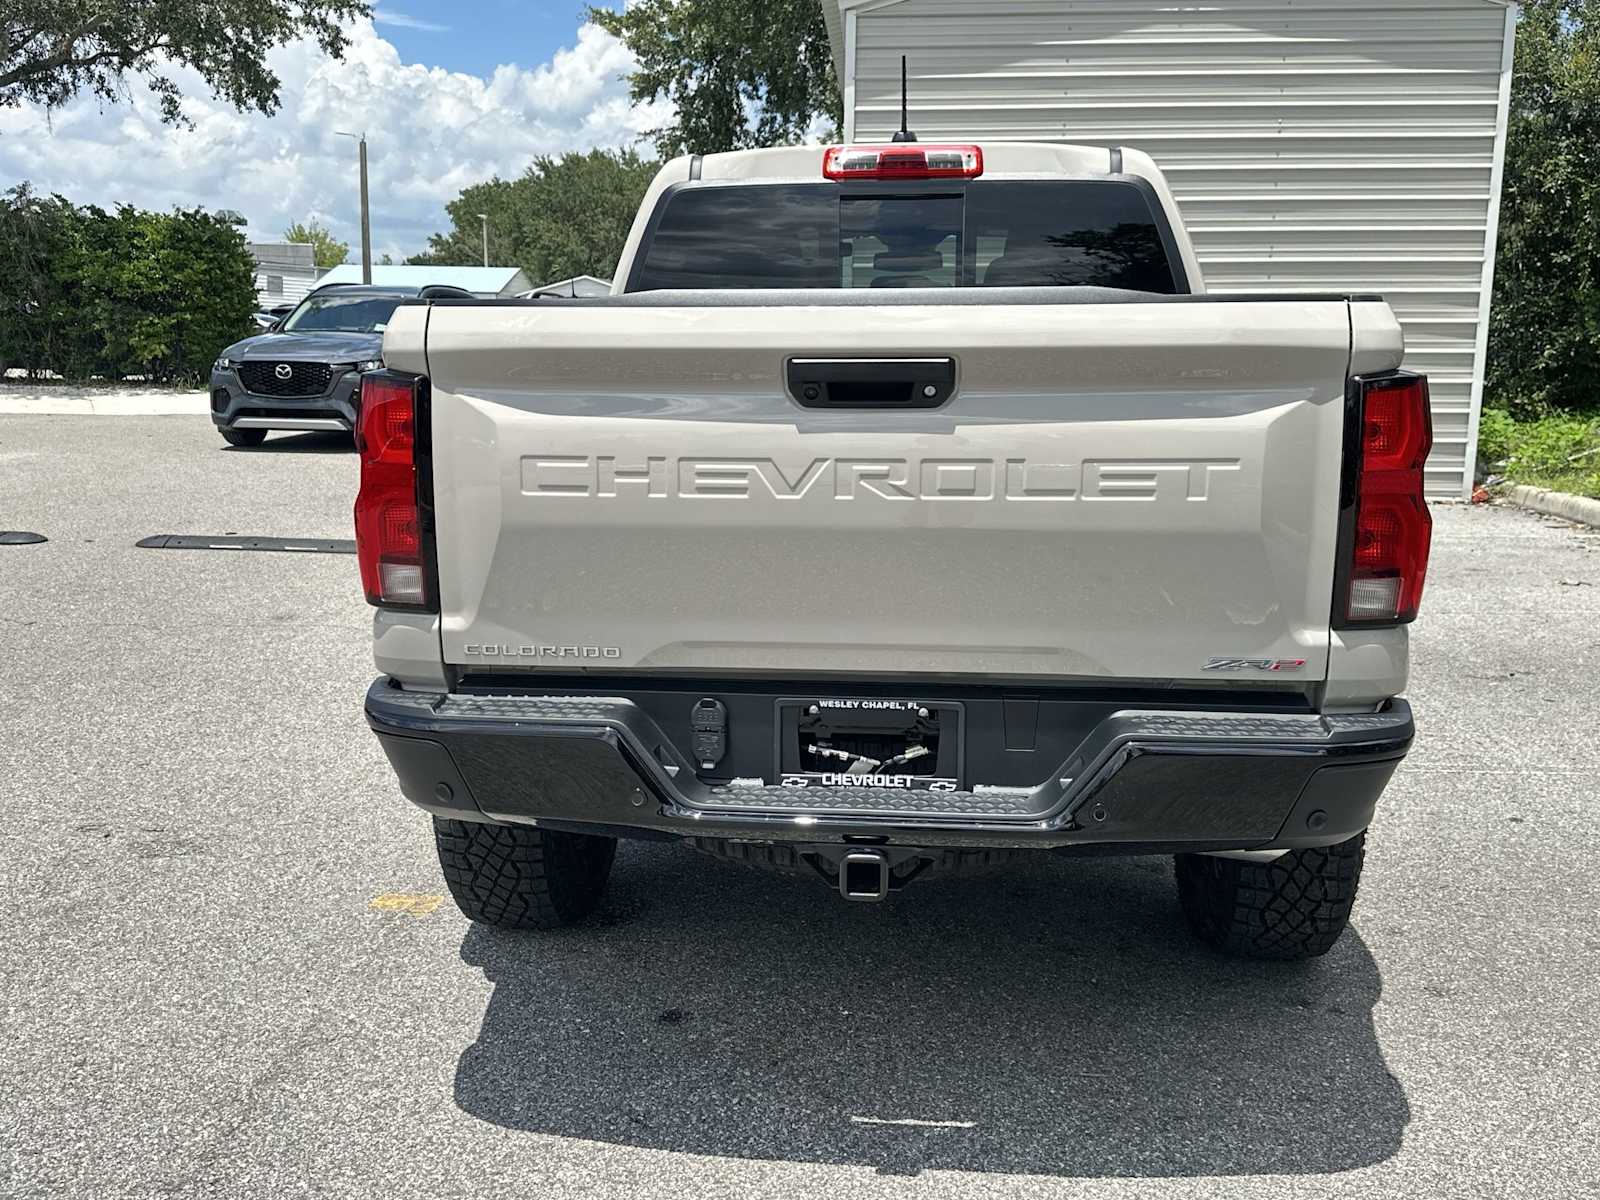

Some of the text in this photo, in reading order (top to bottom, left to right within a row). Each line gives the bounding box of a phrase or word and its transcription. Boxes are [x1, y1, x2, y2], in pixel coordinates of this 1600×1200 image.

[519, 454, 1242, 502] CHEVROLET
[463, 643, 622, 659] COLORADO
[819, 700, 920, 711] WESLEY CHAPEL, FL
[821, 773, 914, 787] CHEVROLET
